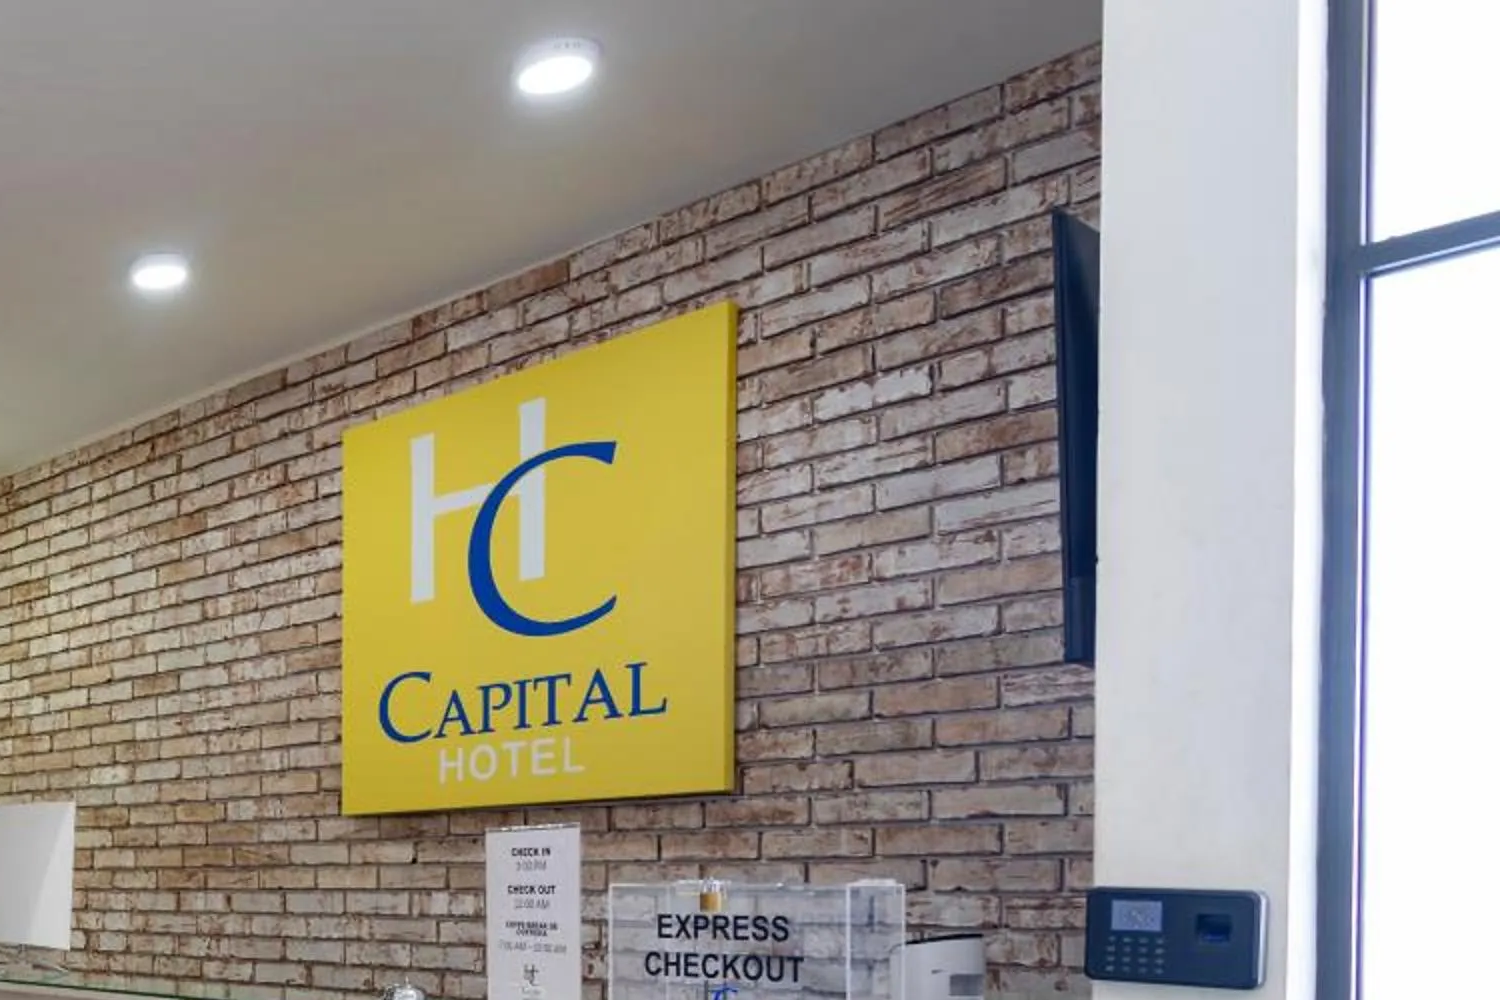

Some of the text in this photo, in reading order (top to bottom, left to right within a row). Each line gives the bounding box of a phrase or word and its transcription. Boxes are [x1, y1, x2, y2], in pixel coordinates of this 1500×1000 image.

[378, 661, 668, 744] CAPITAL
[439, 737, 586, 785] HOTEL
[511, 847, 551, 857] CHECK IN
[507, 884, 556, 895] CHECK OUT
[656, 913, 790, 943] EXPRESS
[644, 951, 805, 983] CHECKOUT
